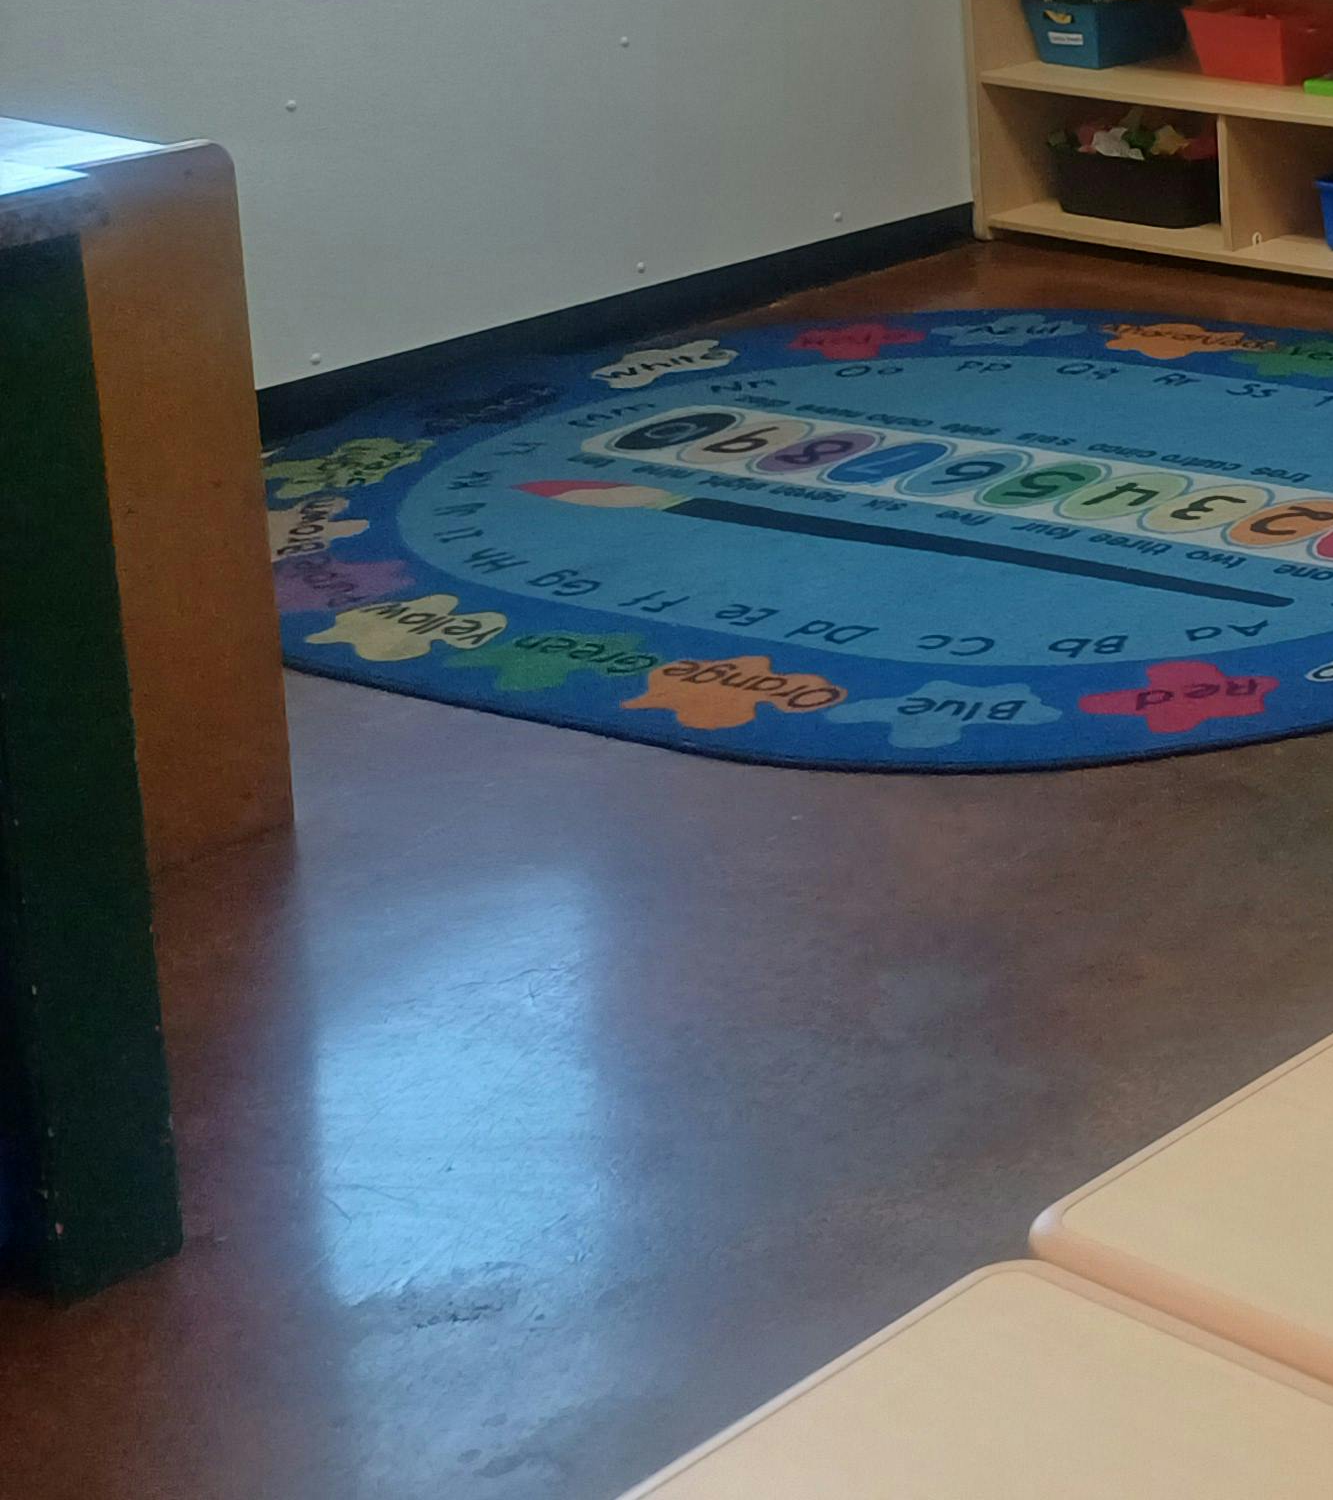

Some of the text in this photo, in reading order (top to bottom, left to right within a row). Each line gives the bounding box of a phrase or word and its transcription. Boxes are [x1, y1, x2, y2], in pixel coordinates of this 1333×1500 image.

[1226, 383, 1279, 398] Ss
[775, 439, 854, 466] 8
[931, 460, 1007, 486] 6
[1004, 470, 1086, 499] 5
[1250, 466, 1313, 484] tres
[1082, 482, 1161, 507] 4
[1170, 495, 1248, 521] 3
[1010, 521, 1082, 541] four
[1088, 533, 1175, 557] three
[1185, 550, 1249, 569] two
[527, 568, 603, 596] Gg
[714, 602, 782, 627] Ee
[784, 619, 880, 645] Dd
[1185, 619, 1270, 642] Aa
[513, 634, 660, 675] Green
[916, 633, 996, 656] Cc
[1049, 634, 1130, 658] Bb
[662, 660, 841, 709] Orange
[1134, 677, 1260, 712] Red
[896, 696, 1027, 722] Blue
